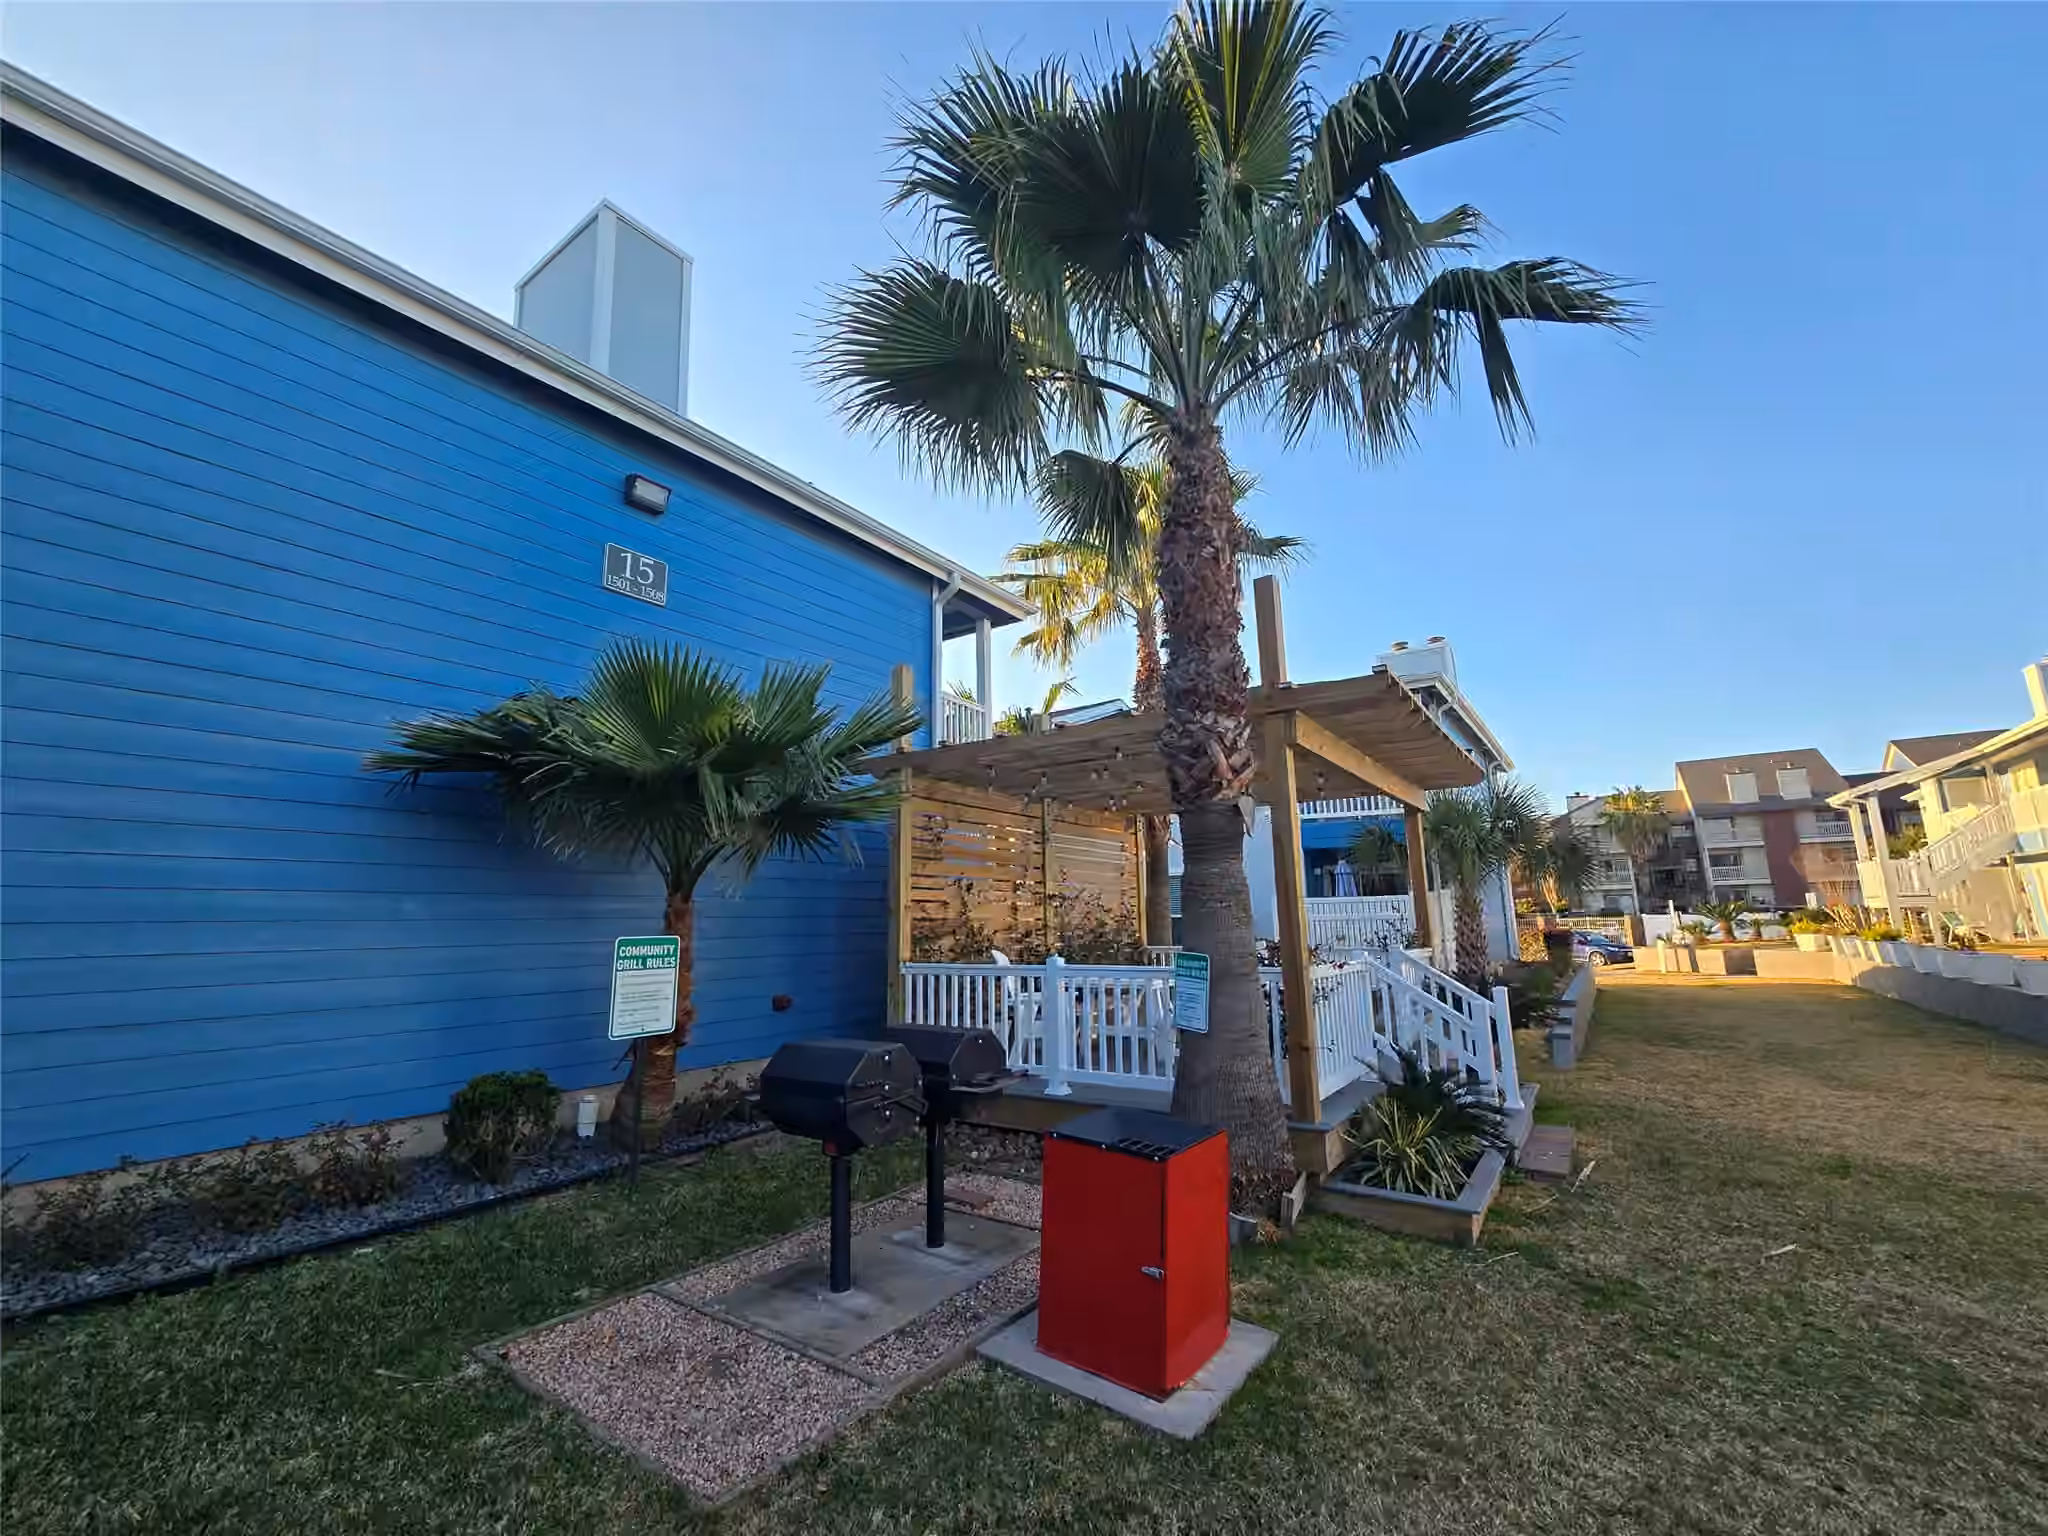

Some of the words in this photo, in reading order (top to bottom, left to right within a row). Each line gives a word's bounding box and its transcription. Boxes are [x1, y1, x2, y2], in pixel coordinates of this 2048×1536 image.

[621, 553, 654, 584] 15
[619, 944, 676, 957] COMMUNITY
[616, 958, 644, 971] GRILL
[646, 957, 676, 969] RULES
